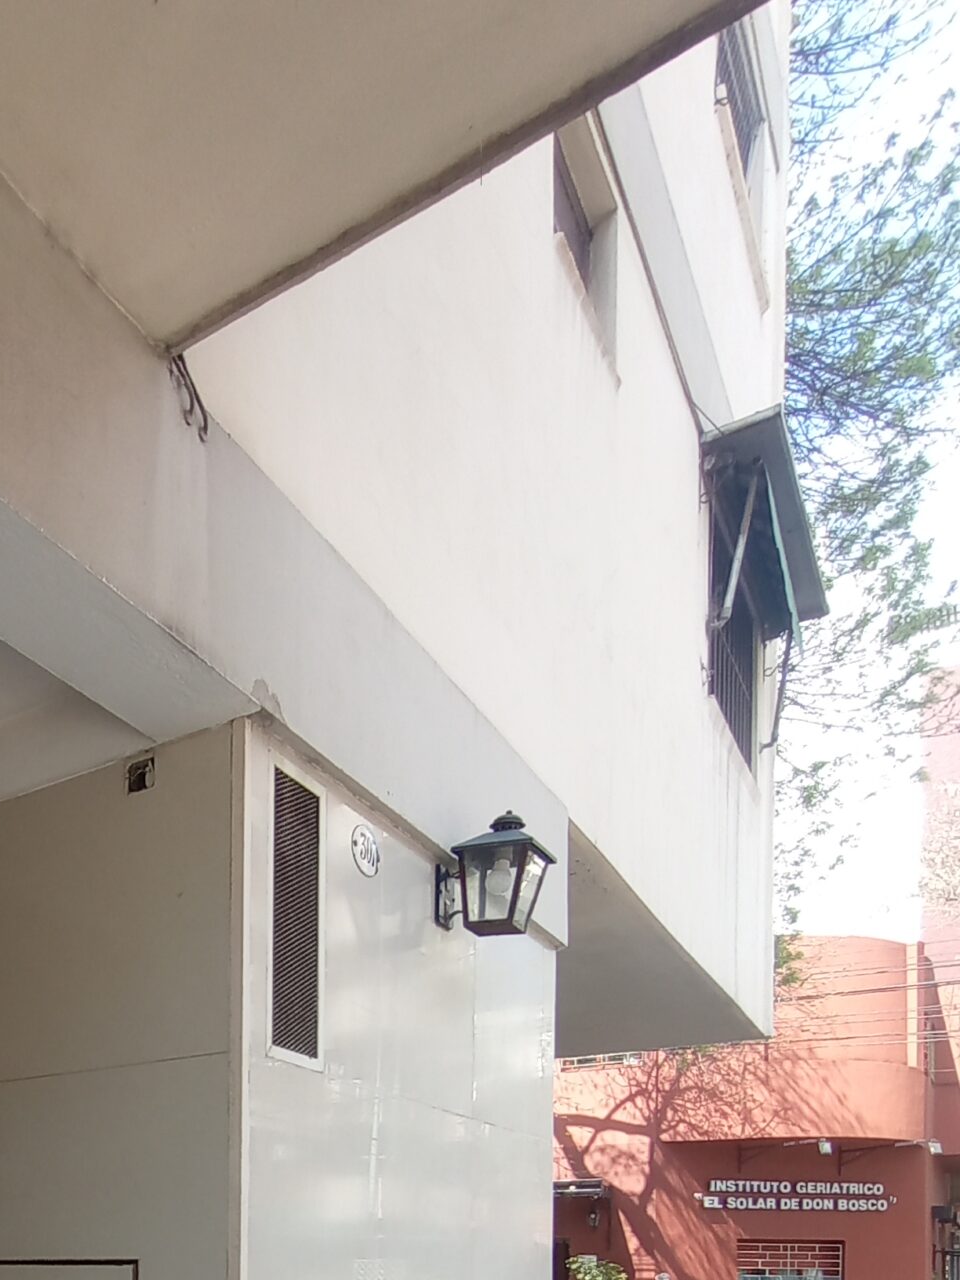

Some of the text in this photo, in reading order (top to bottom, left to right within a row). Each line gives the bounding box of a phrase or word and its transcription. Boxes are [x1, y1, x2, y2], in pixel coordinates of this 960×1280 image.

[709, 1180, 885, 1196] INSTITUTO GERIATRICO
[726, 1196, 777, 1210] SOLAR
[780, 1197, 800, 1210] DE
[802, 1198, 835, 1211] DON
